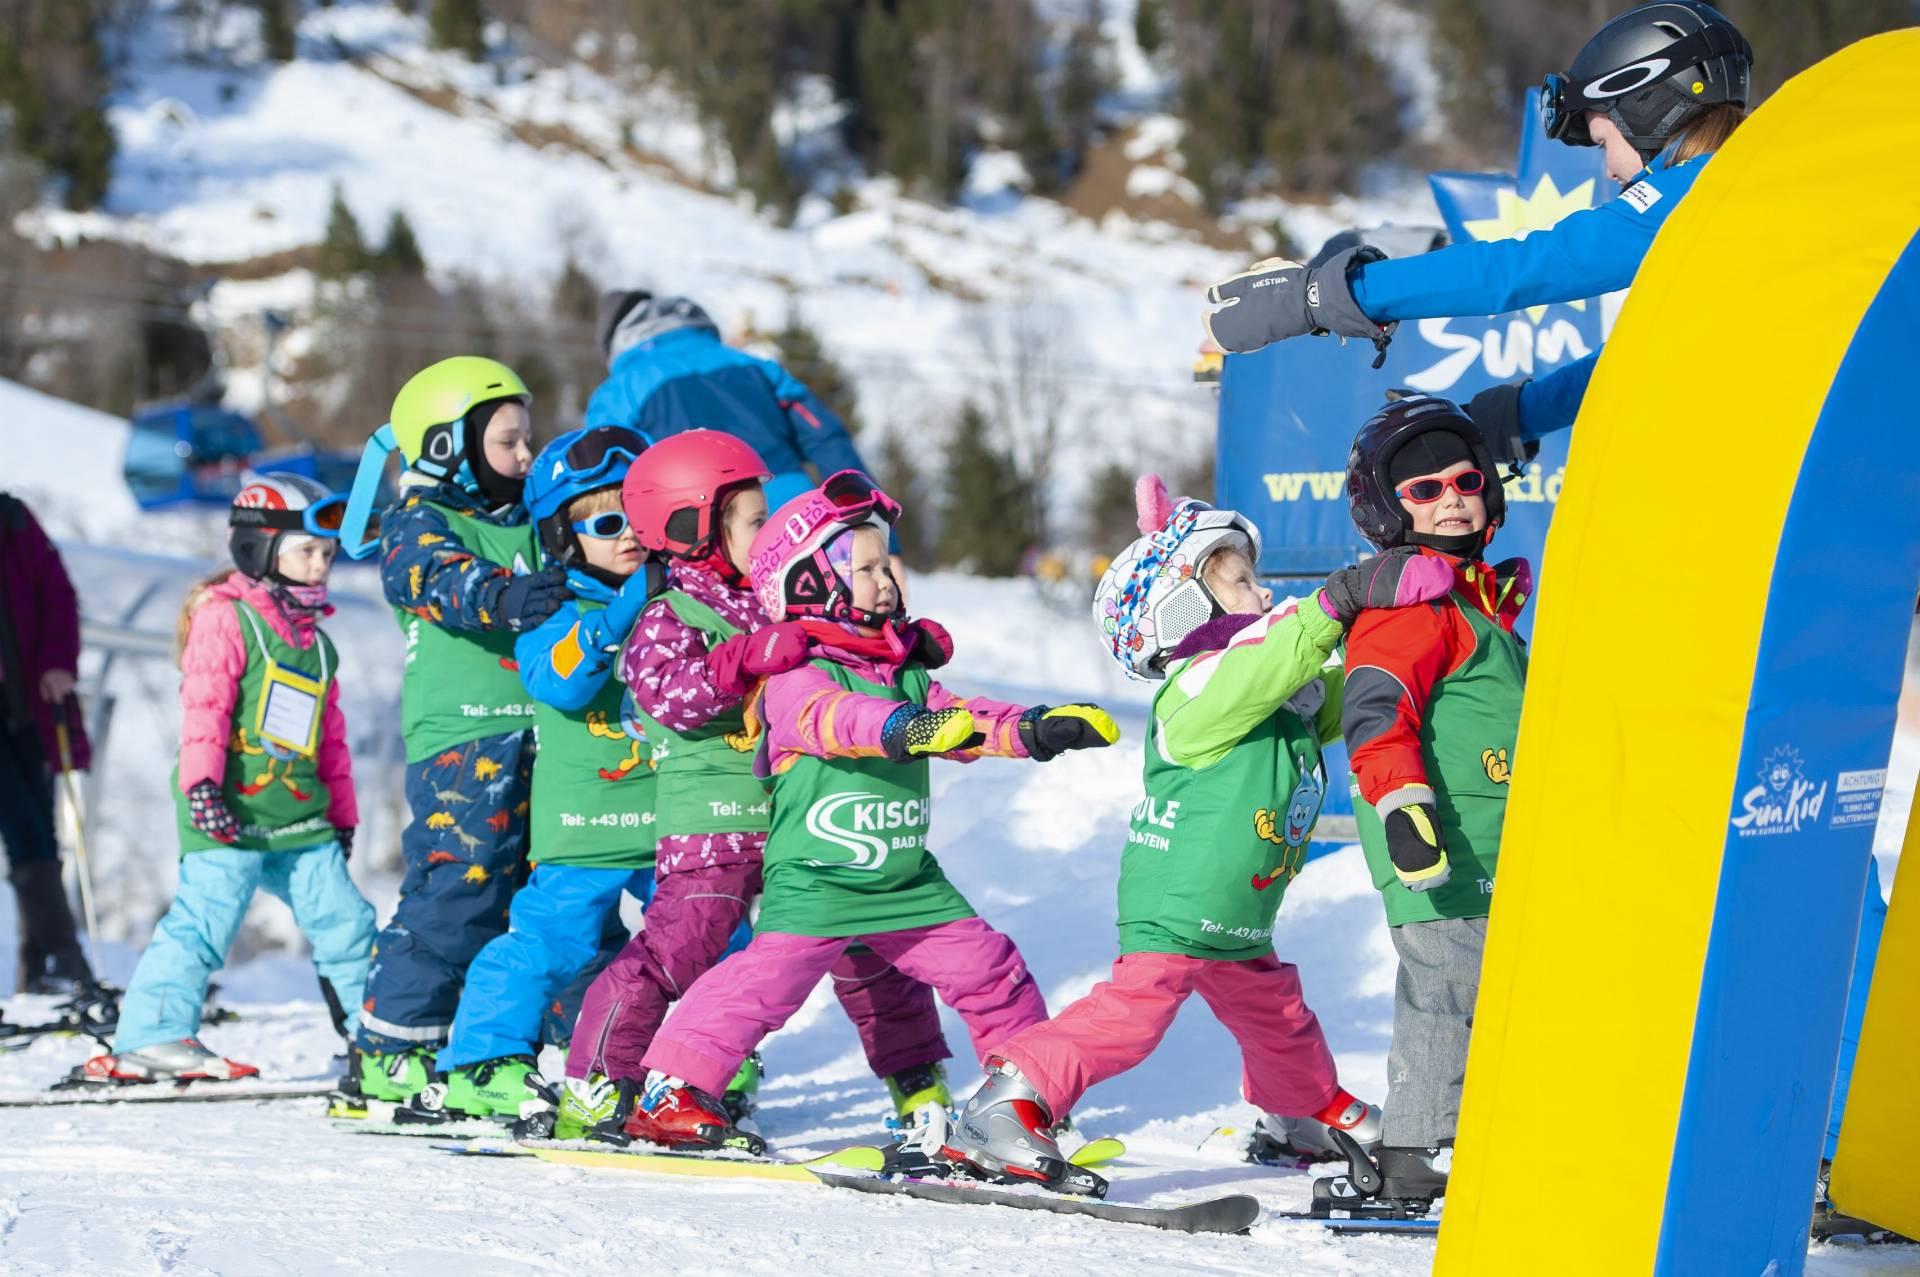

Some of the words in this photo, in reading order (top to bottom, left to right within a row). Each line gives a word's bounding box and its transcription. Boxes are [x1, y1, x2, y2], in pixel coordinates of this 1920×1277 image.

[1252, 277, 1288, 289] HESTRA
[460, 703, 489, 717] Tel:
[493, 703, 523, 717] +43
[708, 801, 742, 817] Tel:
[1731, 779, 1828, 832] SunKid
[559, 812, 586, 827] Tel:
[590, 812, 618, 827] +43
[619, 811, 640, 828] (0)
[891, 835, 916, 850] BAD
[1200, 918, 1225, 934] Tel:
[1226, 926, 1250, 938] +43
